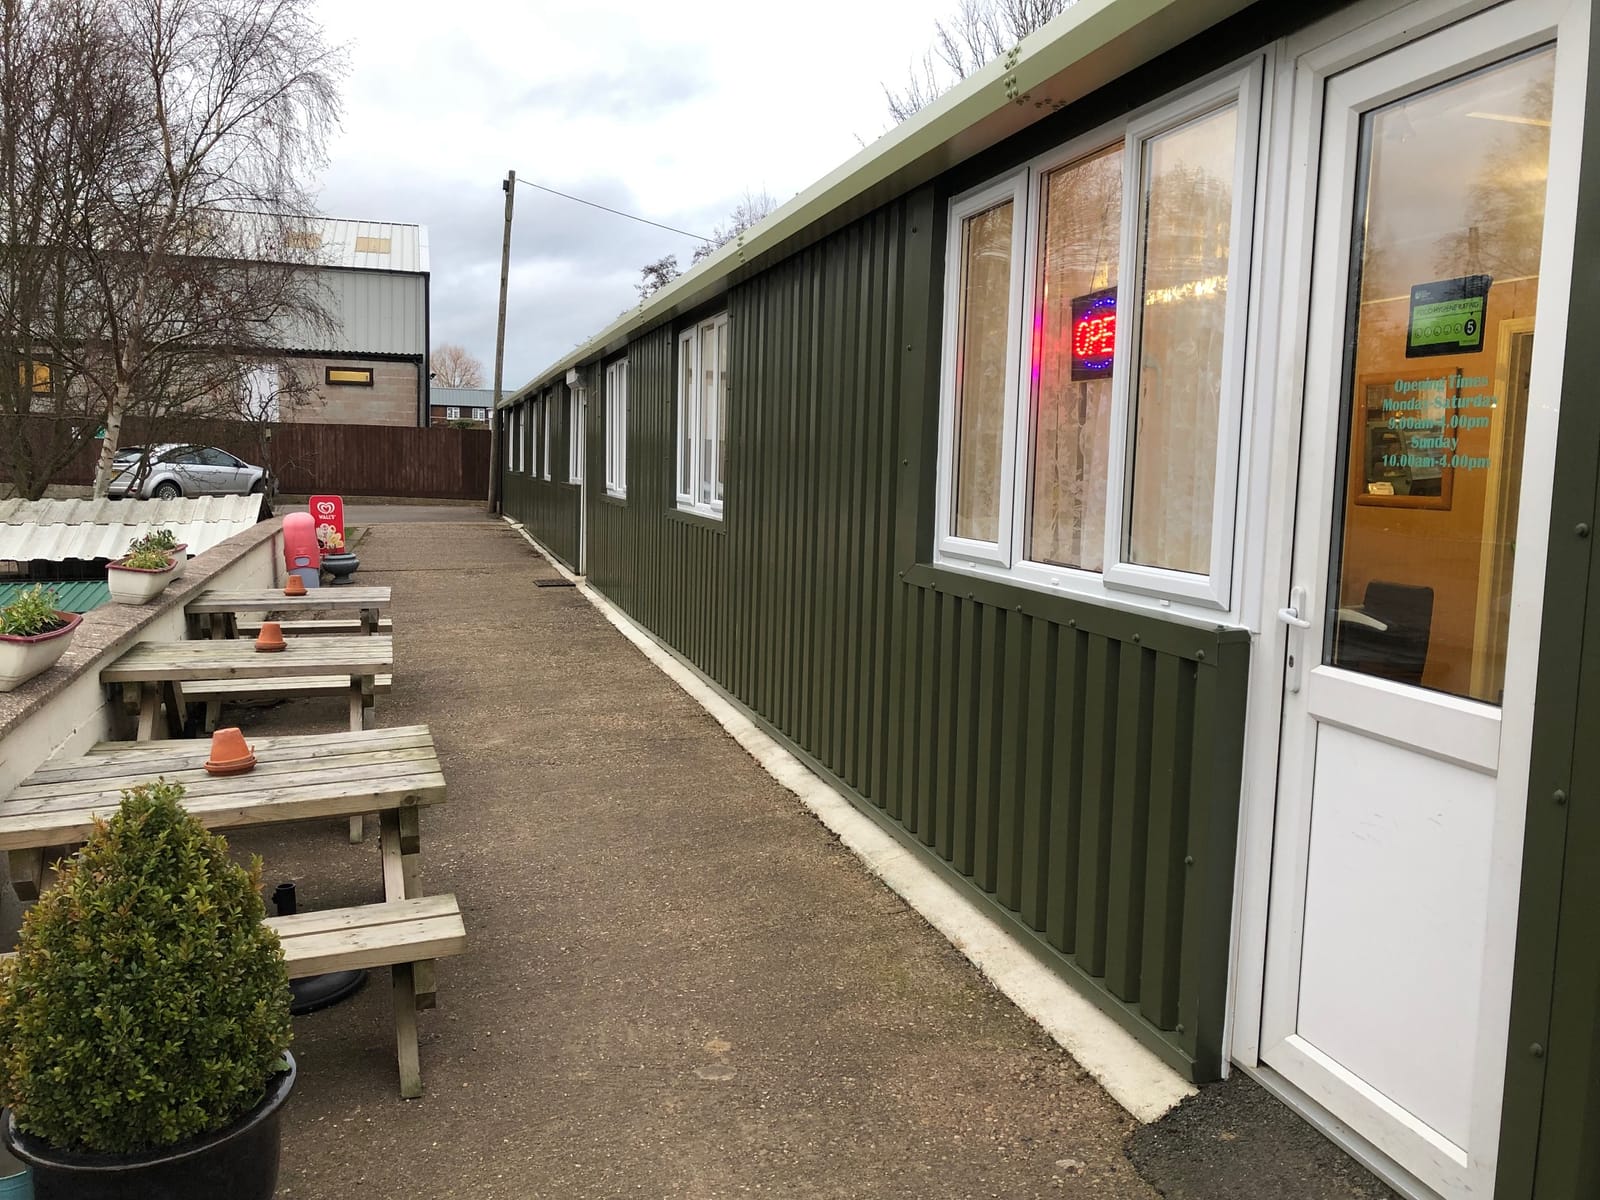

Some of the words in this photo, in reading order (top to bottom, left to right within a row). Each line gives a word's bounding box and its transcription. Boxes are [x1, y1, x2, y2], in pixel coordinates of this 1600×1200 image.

[1075, 315, 1116, 355] OPE
[1394, 377, 1446, 394] Opening
[1448, 374, 1489, 389] Times
[1410, 435, 1459, 451] Sunday
[1382, 453, 1492, 471] 10.00am-4.00pm
